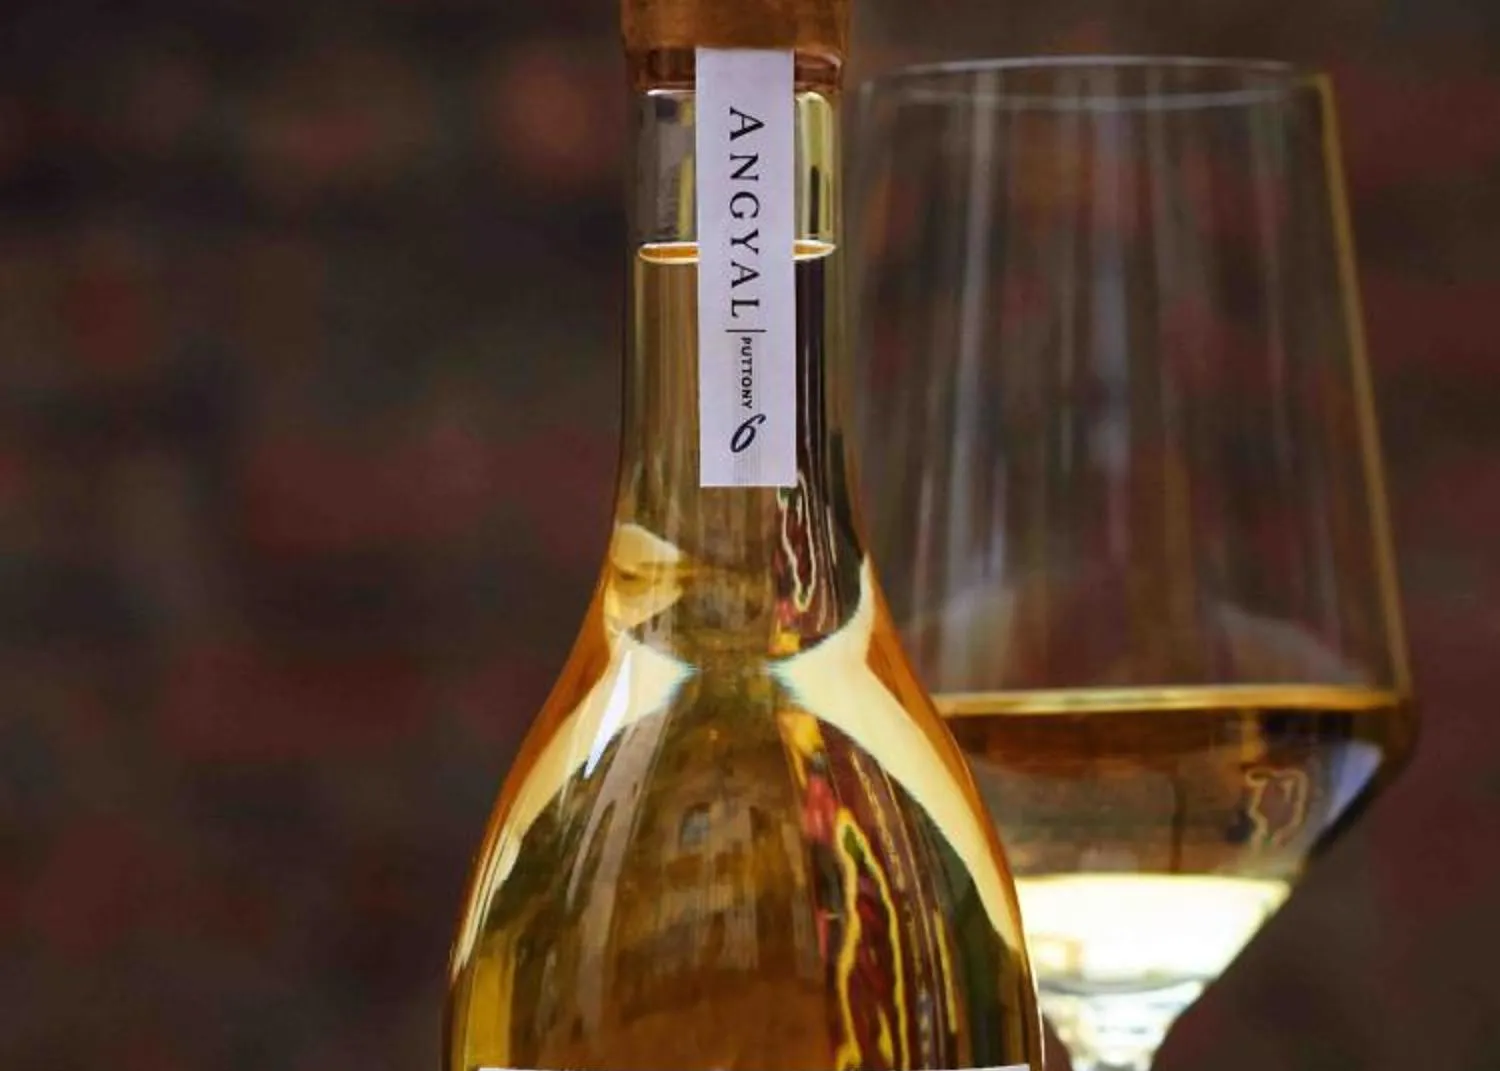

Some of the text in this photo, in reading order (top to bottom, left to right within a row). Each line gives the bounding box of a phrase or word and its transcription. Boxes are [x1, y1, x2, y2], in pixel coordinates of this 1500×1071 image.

[729, 106, 766, 453] ANGYAL PUTTONY 6
